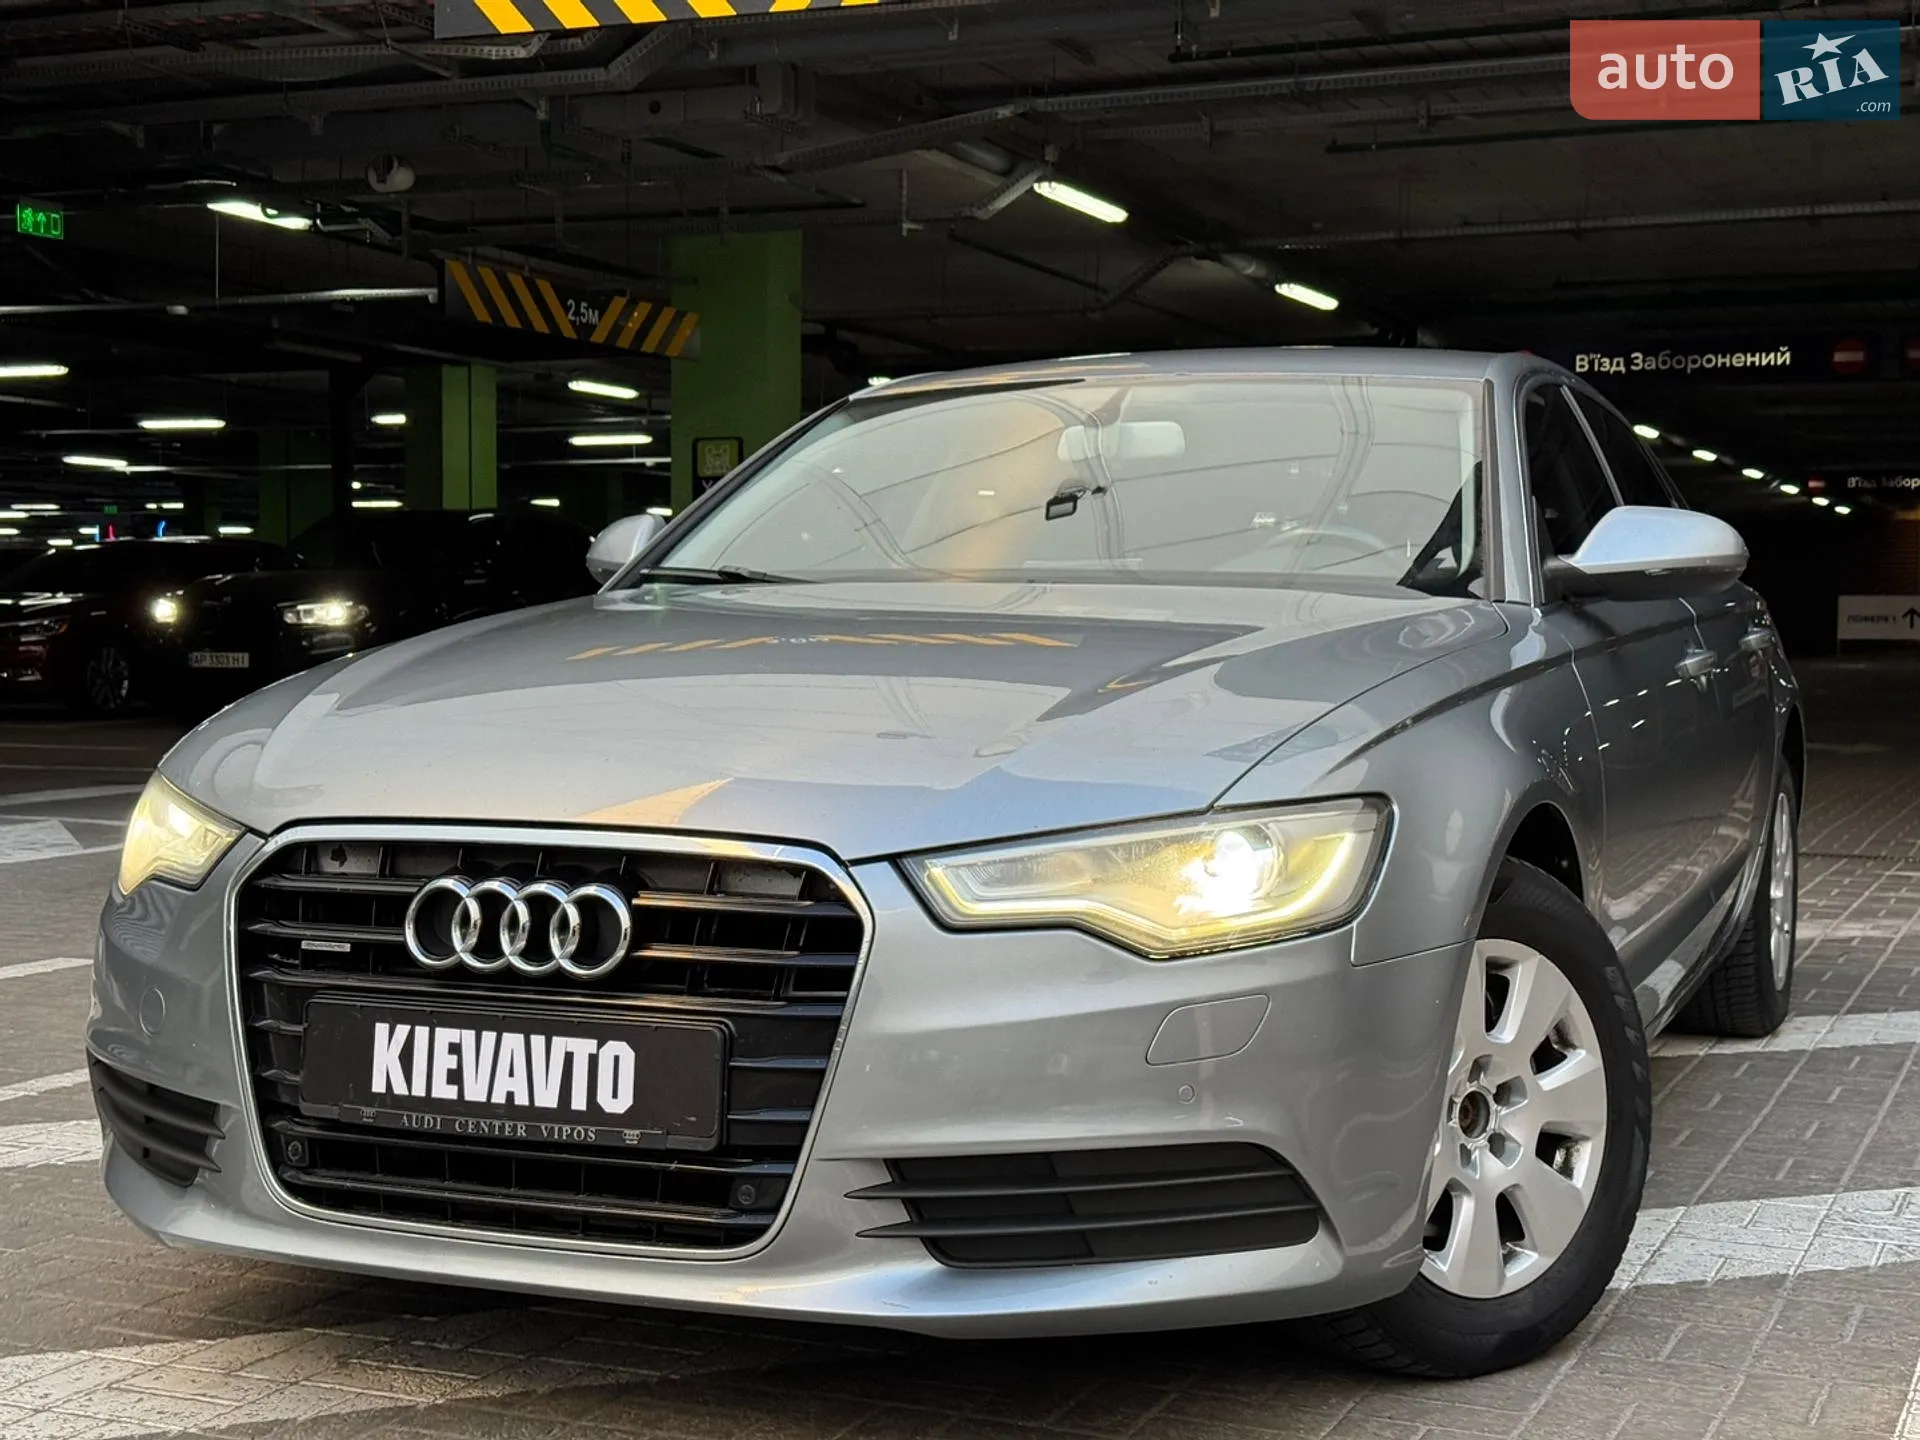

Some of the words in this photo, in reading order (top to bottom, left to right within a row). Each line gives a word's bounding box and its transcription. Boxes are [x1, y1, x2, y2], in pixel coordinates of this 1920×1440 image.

[1575, 353, 1626, 375] В'їзд
[1630, 346, 1791, 374] Заборонений
[371, 1022, 636, 1115] KIEVAVTO
[400, 1114, 443, 1131] AUDI
[455, 1118, 528, 1138] CENTER
[540, 1124, 597, 1142] VIPOS
